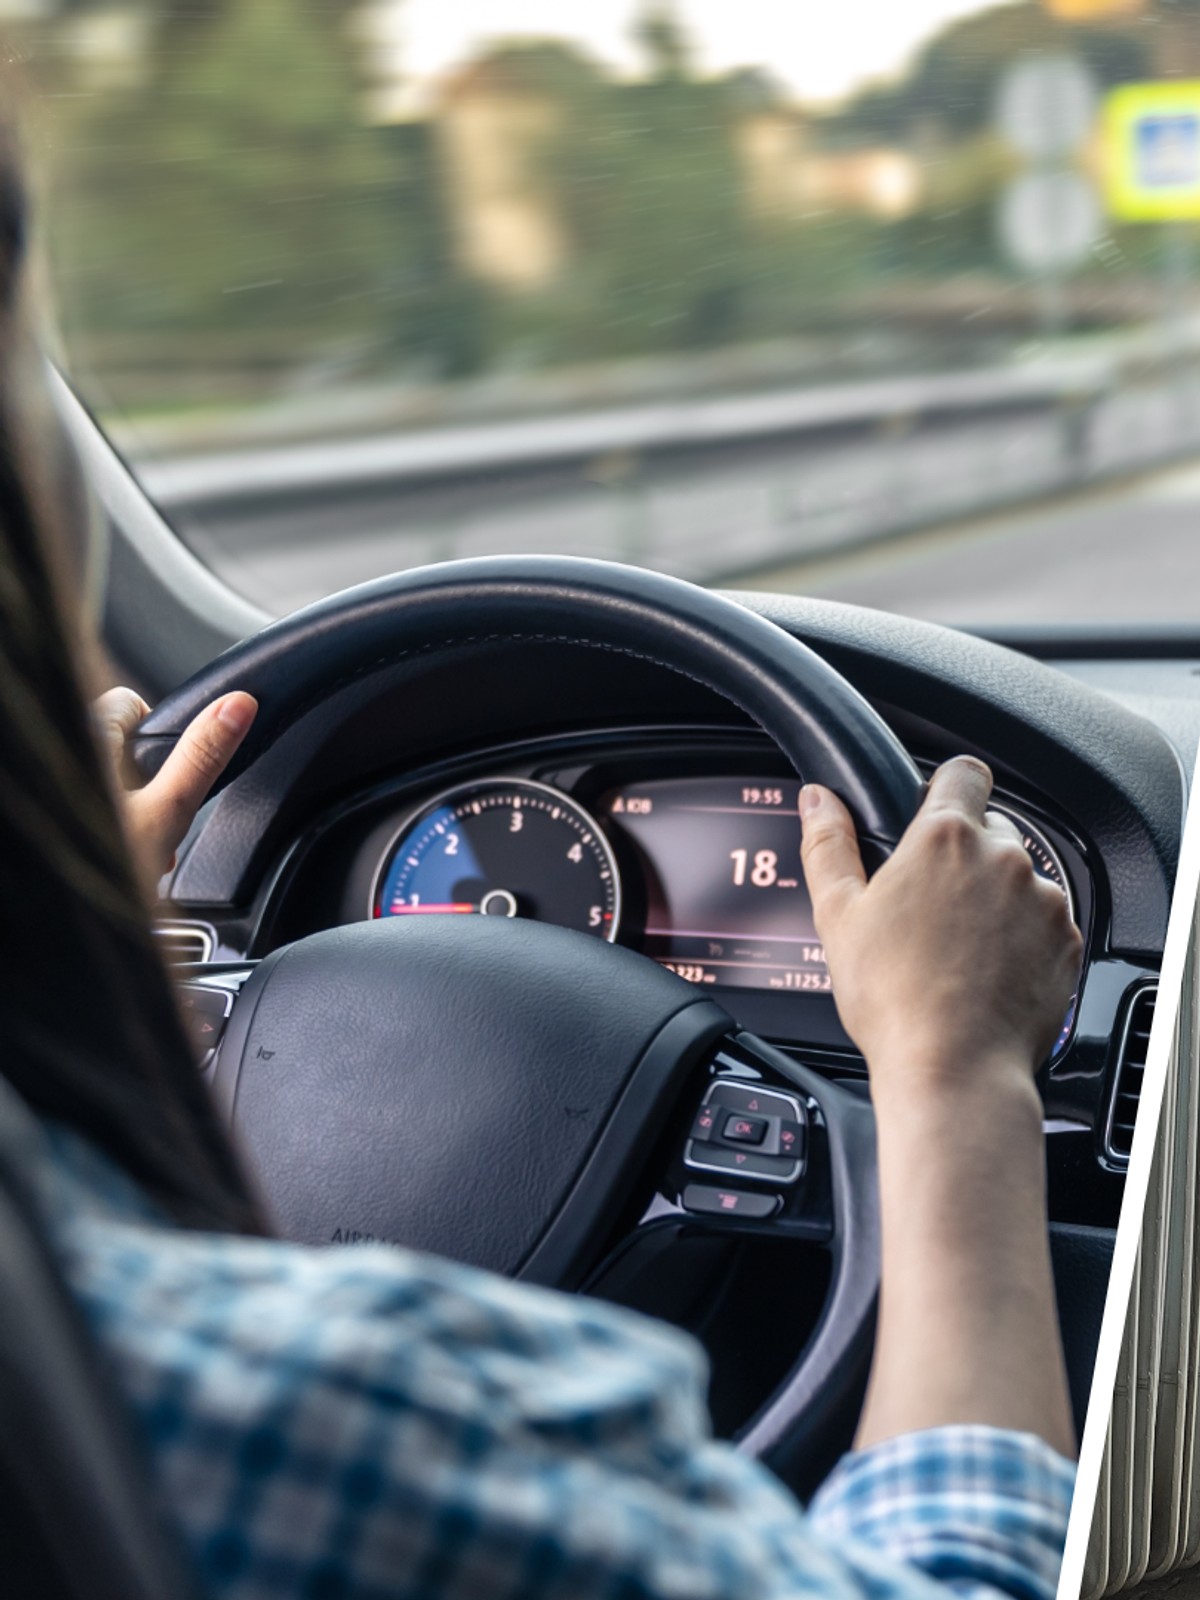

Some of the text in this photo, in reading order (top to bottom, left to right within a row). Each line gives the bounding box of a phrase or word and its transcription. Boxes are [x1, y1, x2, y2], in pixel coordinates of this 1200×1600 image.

[742, 787, 783, 805] 19:55
[510, 811, 523, 832] 3
[444, 833, 460, 856] 2
[566, 842, 583, 864] 4
[730, 849, 777, 888] 18
[410, 893, 420, 908] 1
[589, 906, 603, 927] 5
[735, 1121, 753, 1134] OK
